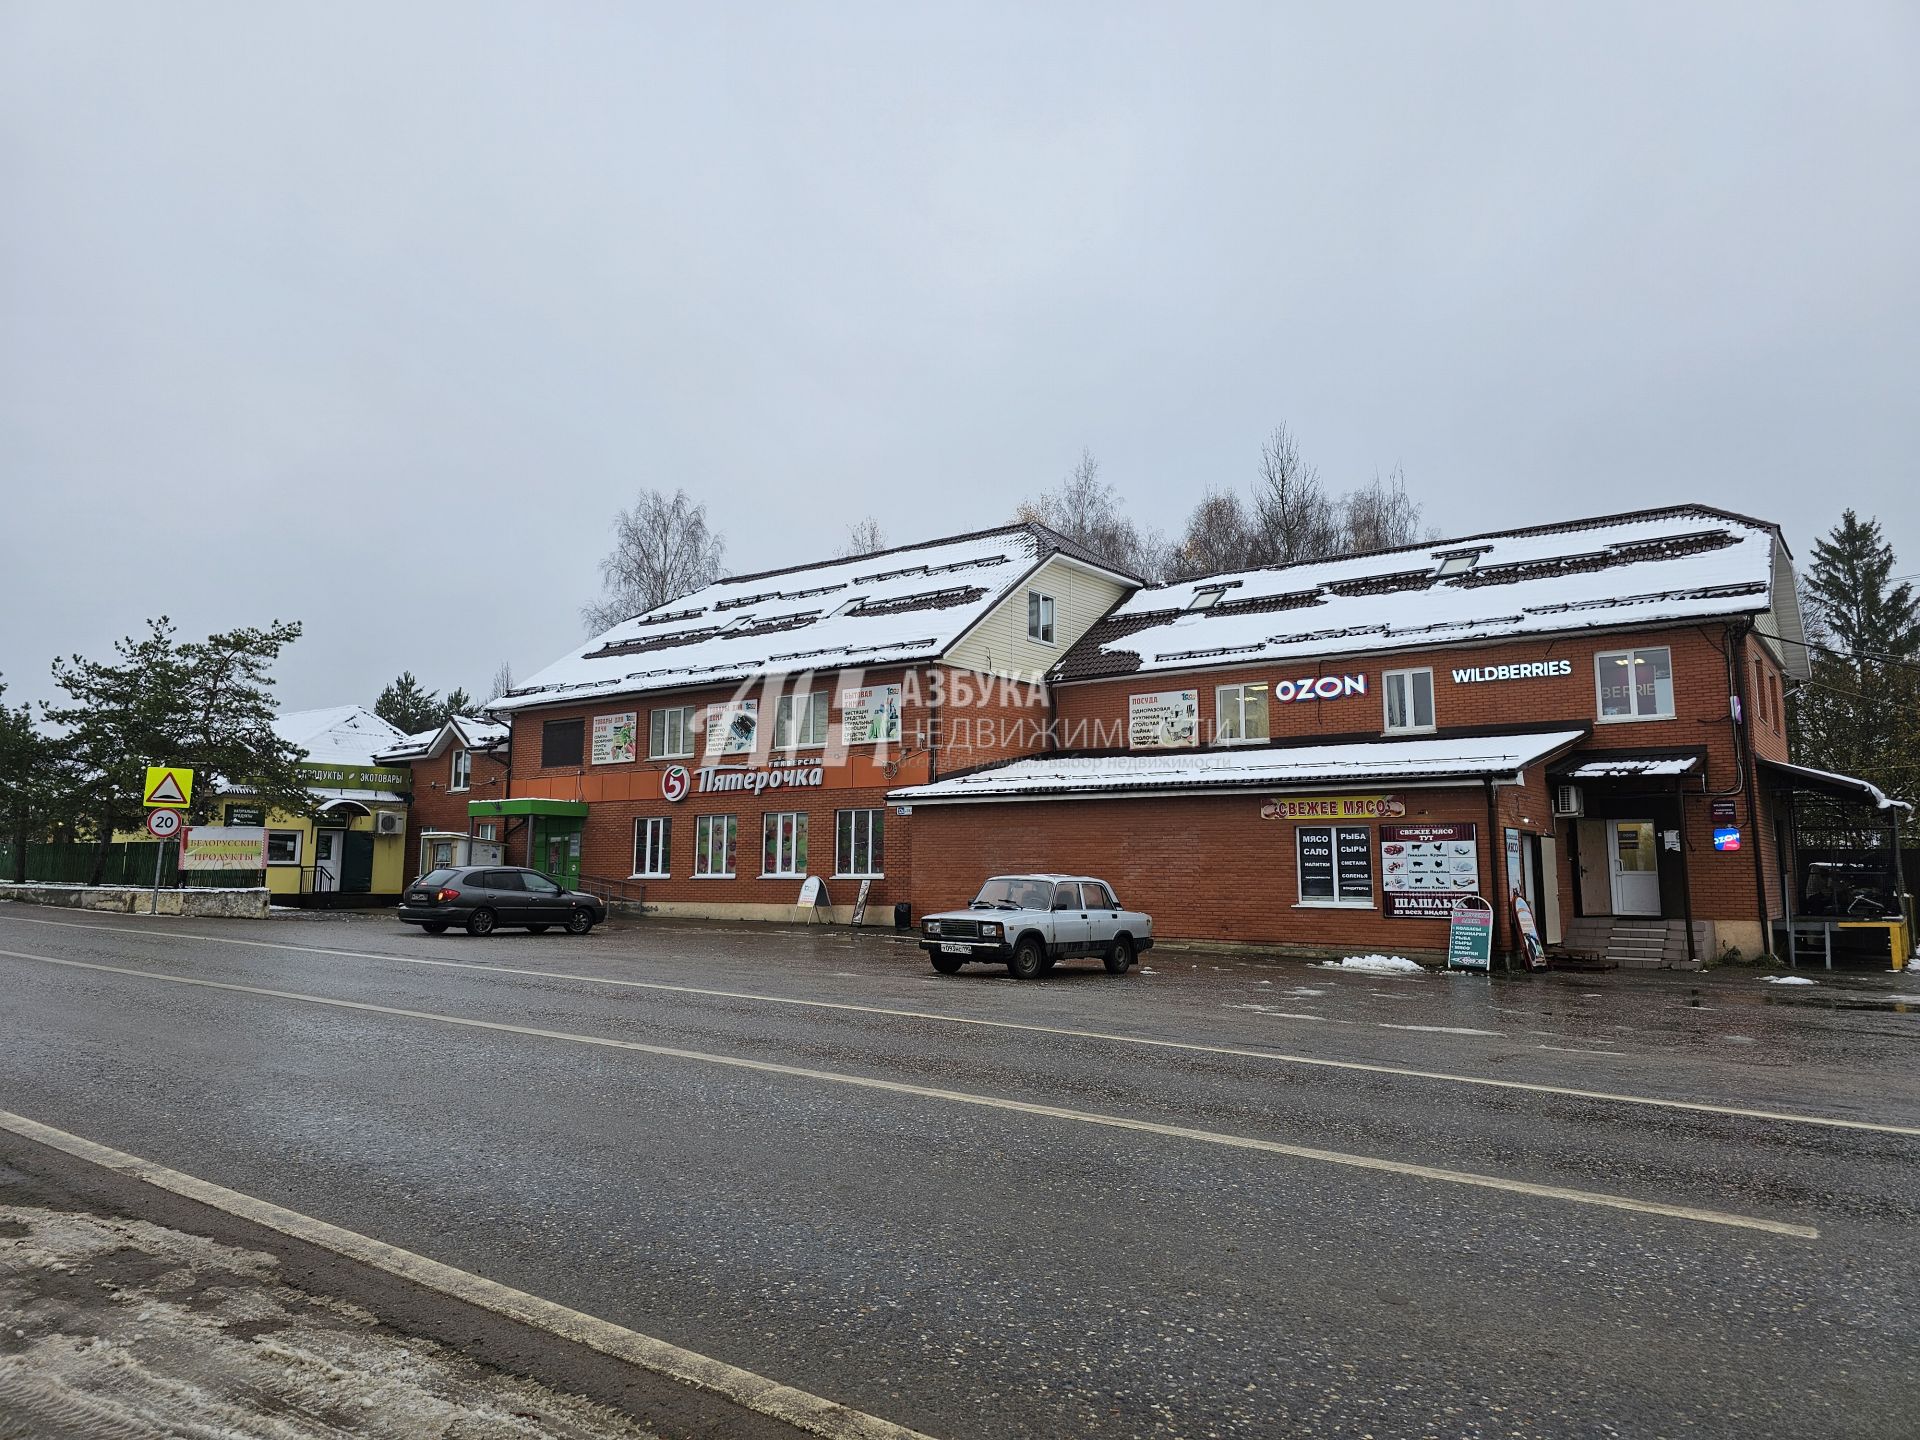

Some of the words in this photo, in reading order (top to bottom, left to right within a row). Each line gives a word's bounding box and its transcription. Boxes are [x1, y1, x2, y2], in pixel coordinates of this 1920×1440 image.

[1452, 660, 1572, 683] WILDBERRIES
[1275, 674, 1366, 702] OZON
[844, 690, 872, 699] БЫТОВАЯ
[1132, 697, 1158, 705] ПОСУДА
[360, 772, 403, 784] ЭКОТОВАРЫ
[1278, 802, 1338, 816] СВЕЖЕЕ
[1343, 800, 1386, 815] МЯСО
[155, 816, 174, 829] 20
[191, 839, 258, 847] БЕЛОРУССКИЕ
[1304, 848, 1329, 856] САЛО
[1340, 845, 1367, 853] СЫРЫ
[194, 853, 253, 861] ПРОДУКТЫ
[1395, 898, 1469, 909] ШАШЛЫК
